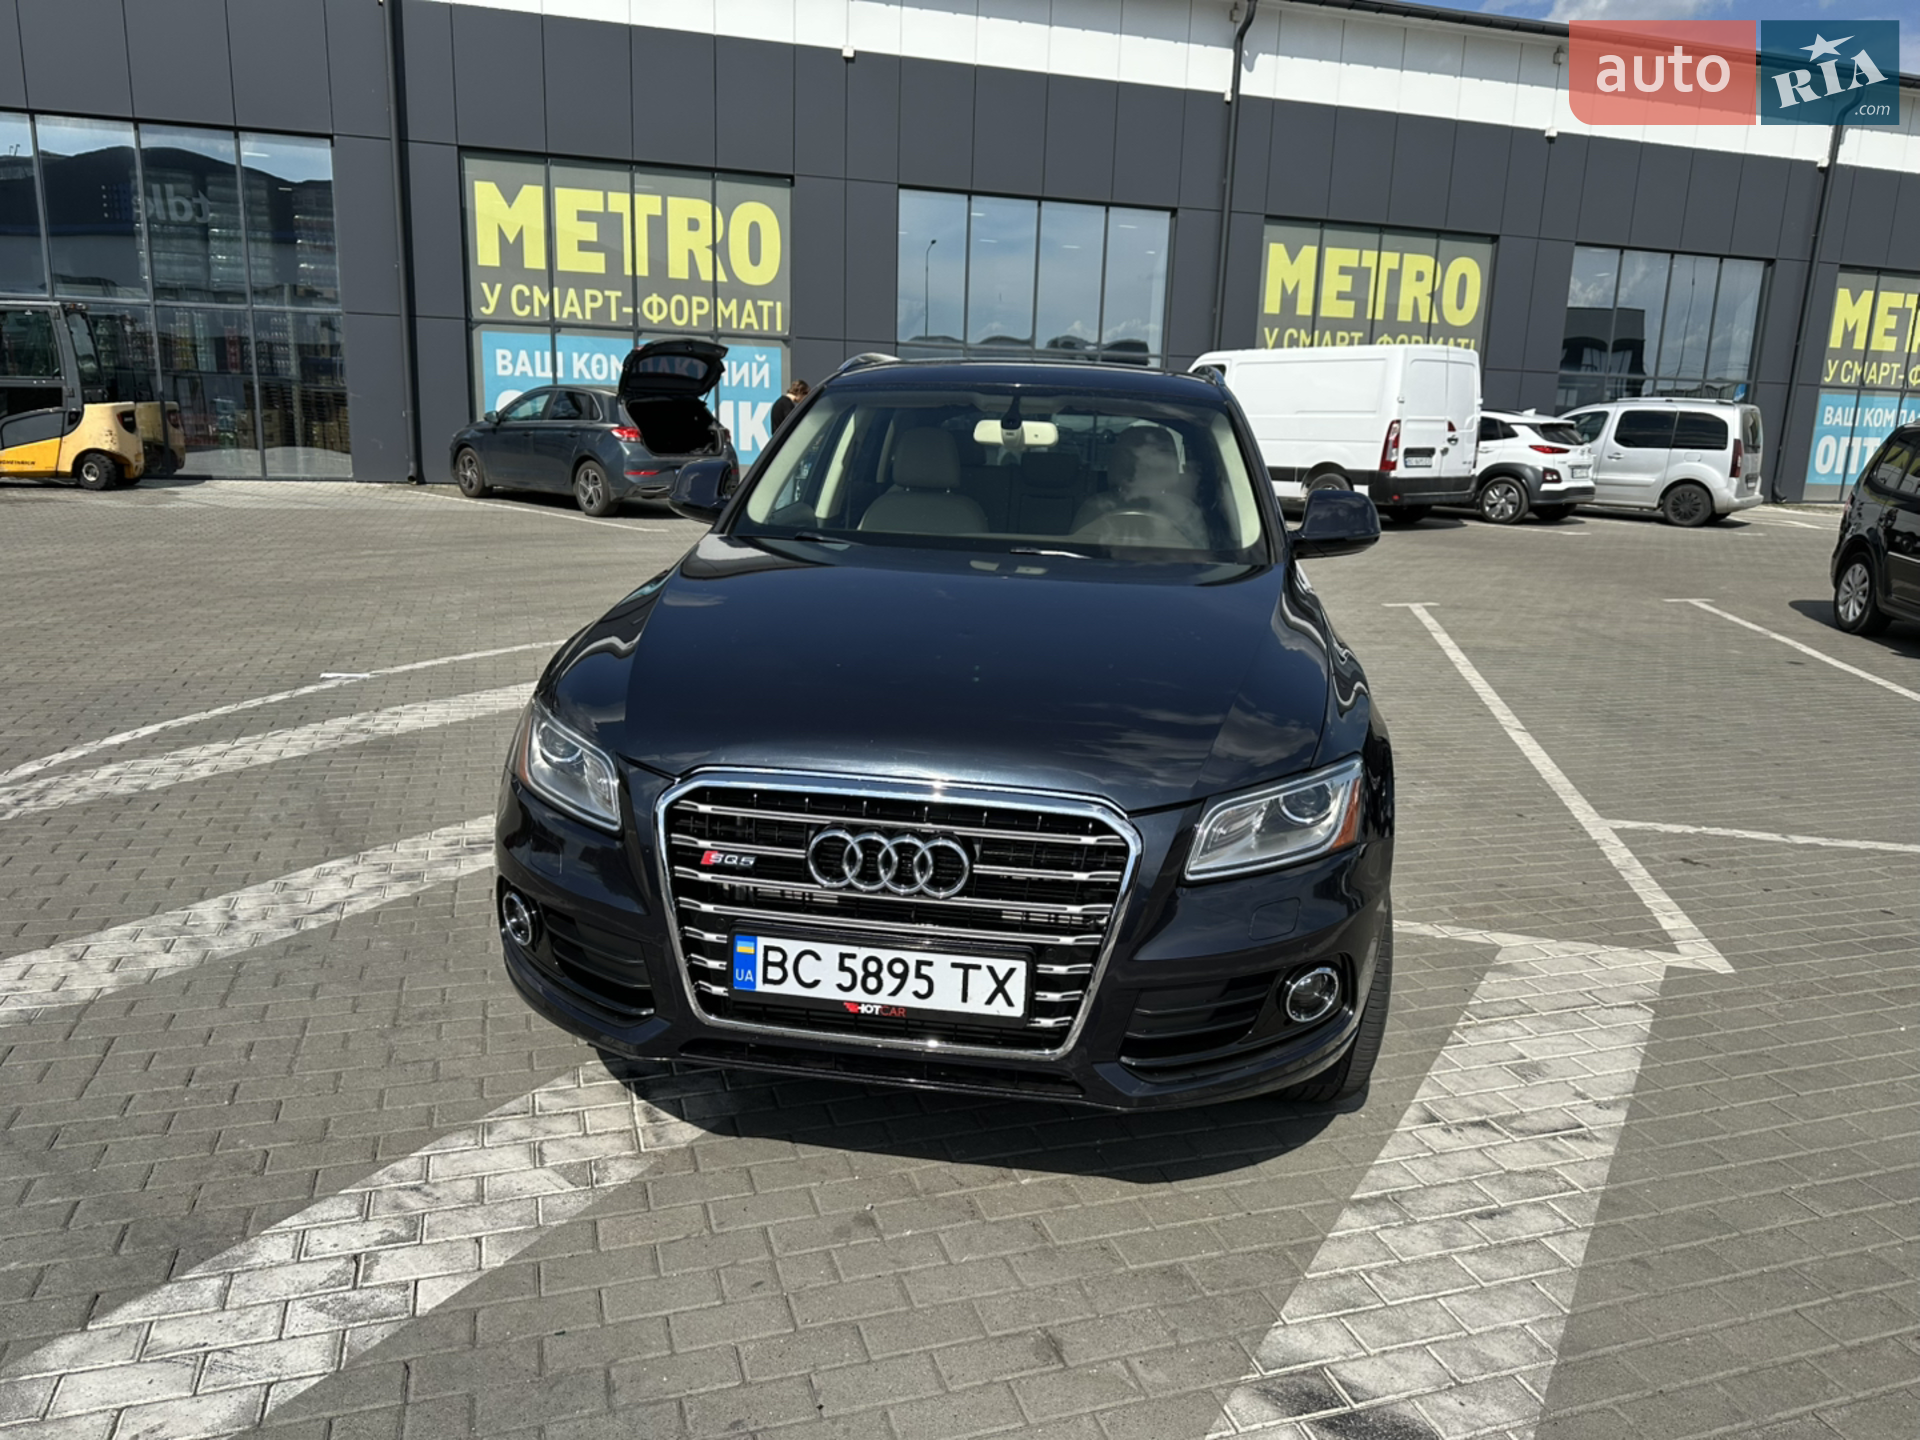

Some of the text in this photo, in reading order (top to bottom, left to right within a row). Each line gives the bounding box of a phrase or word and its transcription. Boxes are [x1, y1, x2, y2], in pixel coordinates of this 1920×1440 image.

[474, 180, 781, 286] METRO
[1264, 242, 1481, 327] METRO
[480, 282, 782, 332] У СМАРТ-ФОРМАТІ
[495, 348, 564, 379] ВАШ
[1824, 359, 1839, 383] У
[1823, 405, 1861, 428] ВАШ
[708, 852, 757, 866] SQ5
[735, 968, 754, 983] UA
[762, 944, 1018, 1008] BC 5895 TX
